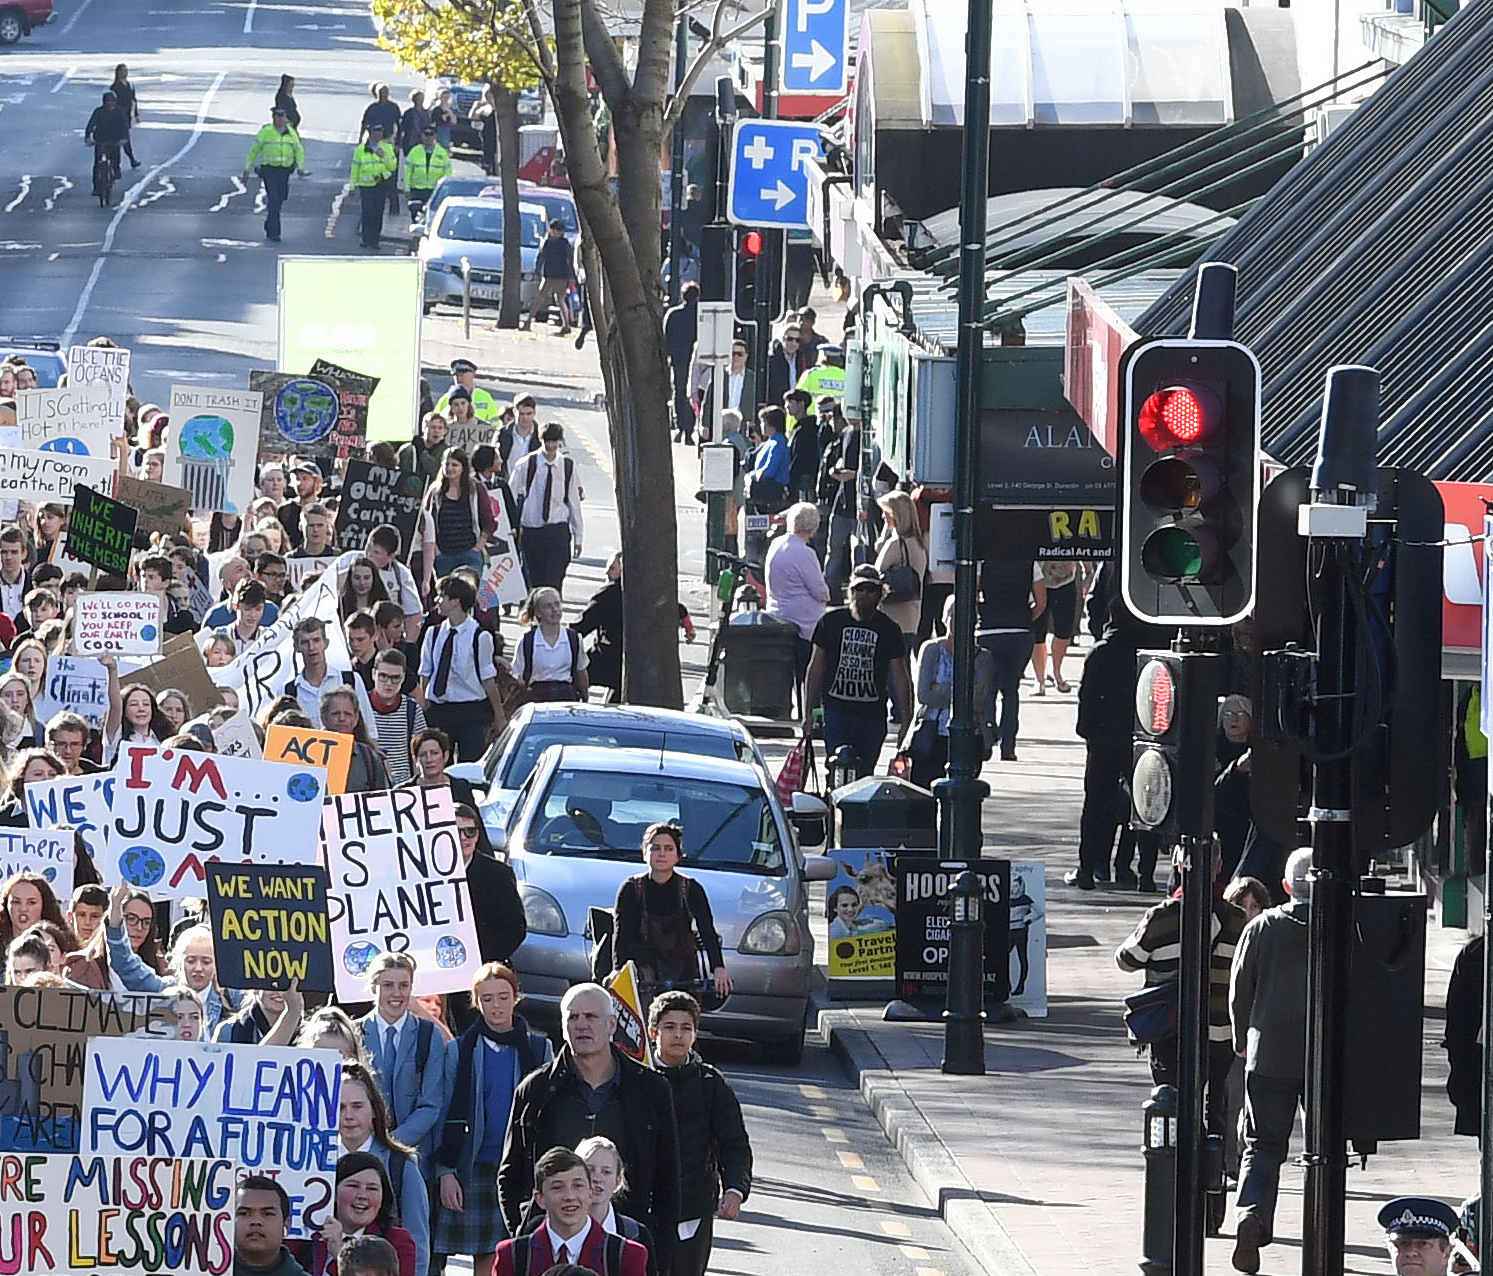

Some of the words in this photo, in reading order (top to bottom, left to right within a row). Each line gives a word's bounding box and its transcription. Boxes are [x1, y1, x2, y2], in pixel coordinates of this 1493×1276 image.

[798, 0, 834, 32] P
[71, 349, 102, 365] LIKE
[103, 351, 130, 367] THE
[173, 392, 202, 407] DONT
[205, 393, 241, 409] TRASH
[244, 396, 259, 410] IT
[11, 454, 40, 480] my
[42, 458, 89, 477] room
[89, 496, 114, 518] WE
[68, 533, 94, 556] THE
[93, 547, 127, 572] MESS
[1039, 546, 1075, 557] Radical
[1076, 547, 1091, 557] Art
[1092, 547, 1112, 557] and
[83, 640, 124, 651] COOL
[842, 627, 876, 645] GLOBAL
[56, 658, 76, 672] the
[837, 667, 875, 682] RIGHT
[830, 682, 879, 700] NOW
[283, 736, 339, 765] ACT
[215, 875, 251, 898] WE
[259, 876, 316, 899] WANT
[222, 908, 328, 943] ACTION
[243, 948, 308, 980] NOW
[94, 1051, 214, 1112] WHY
[223, 1053, 341, 1128] LEARN
[90, 1107, 176, 1152] FOR
[182, 1114, 213, 1157] A
[218, 1117, 339, 1172] FUTURE
[68, 1209, 232, 1276] LESSONS
